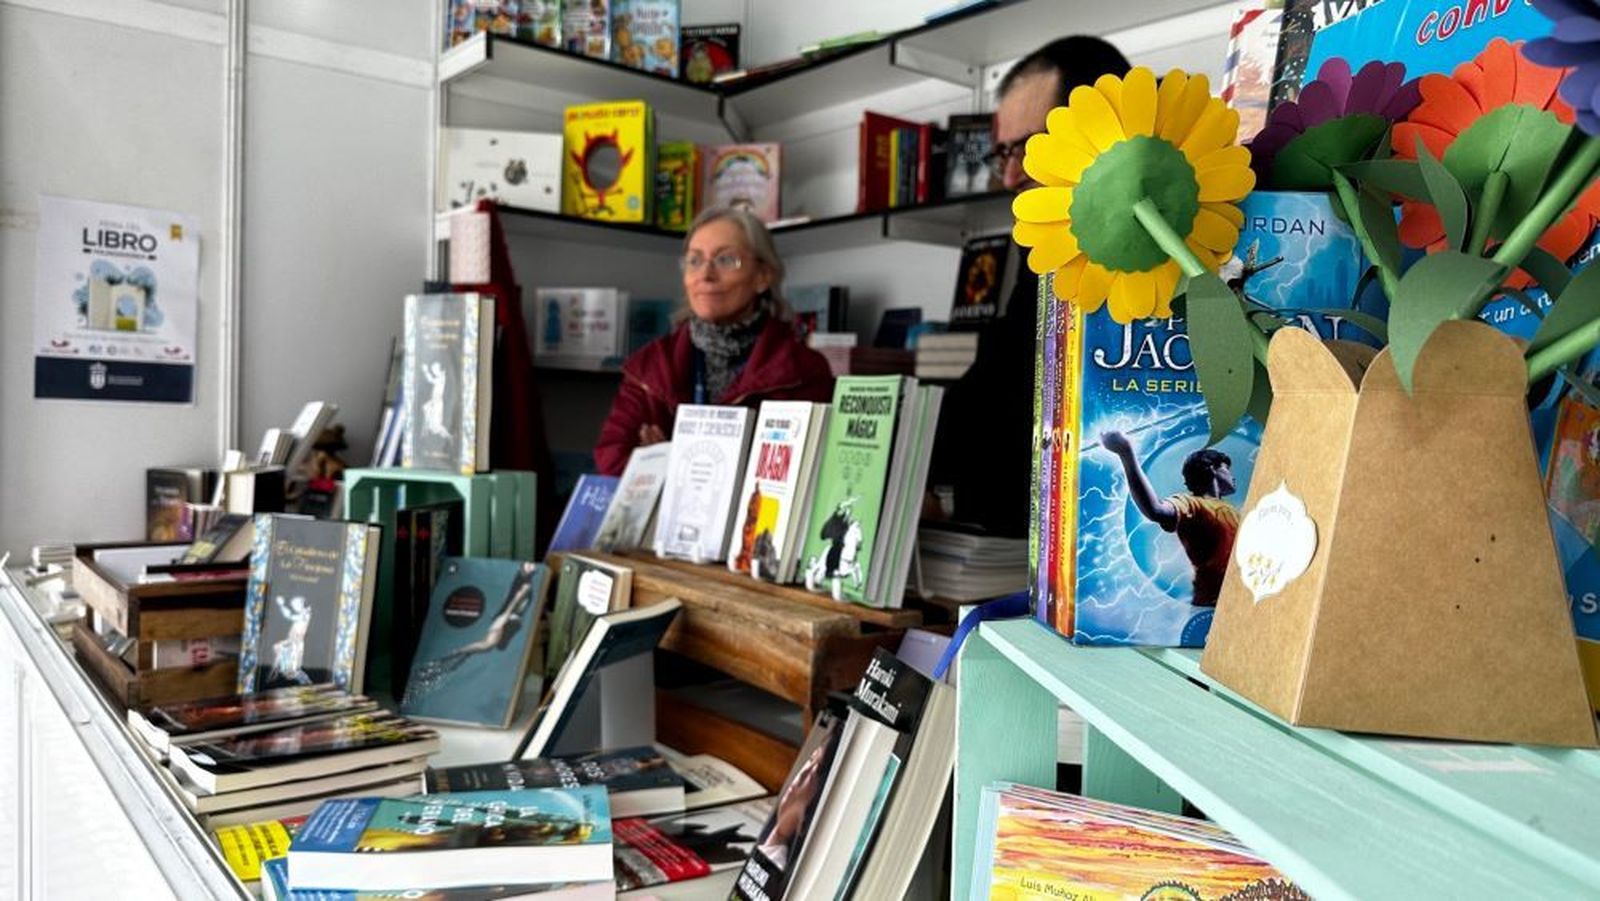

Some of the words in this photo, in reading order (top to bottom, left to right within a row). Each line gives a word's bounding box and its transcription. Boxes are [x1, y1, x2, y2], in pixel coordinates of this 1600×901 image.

[1242, 216, 1325, 236] RDAN
[82, 227, 158, 253] LIBRO
[1494, 306, 1515, 323] un
[1112, 378, 1140, 392] LA
[866, 657, 897, 688] Haruki
[853, 677, 902, 724] Murakami
[1020, 875, 1041, 892] Luis
